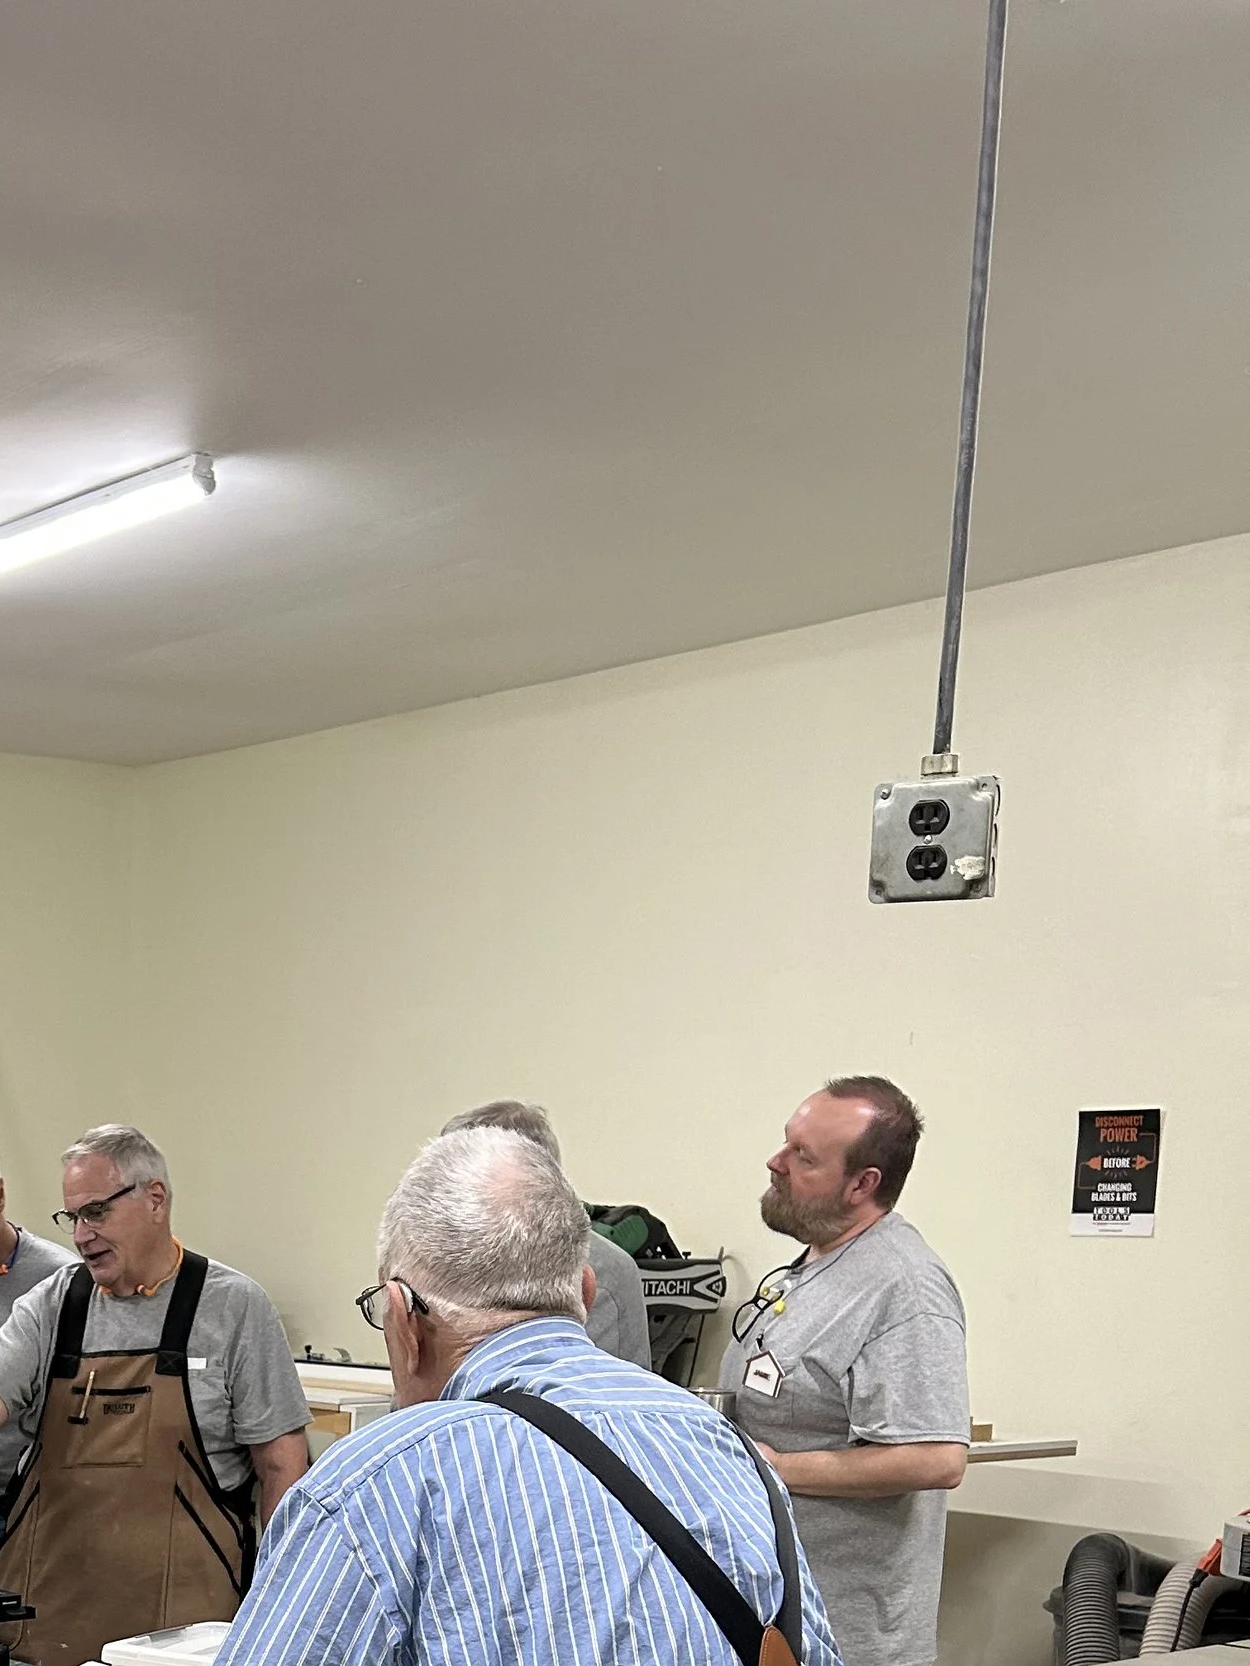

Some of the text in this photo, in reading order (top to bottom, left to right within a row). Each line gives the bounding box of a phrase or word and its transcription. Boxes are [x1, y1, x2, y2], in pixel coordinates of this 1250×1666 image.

[1095, 1115, 1144, 1128] DISCONNECT
[1100, 1127, 1138, 1142] POWER
[1103, 1157, 1131, 1168] BEFORE
[1097, 1183, 1132, 1192] CHANGING
[1091, 1192, 1114, 1202] BLADES
[1122, 1192, 1137, 1202] BITS
[645, 1281, 690, 1295] ITACHI
